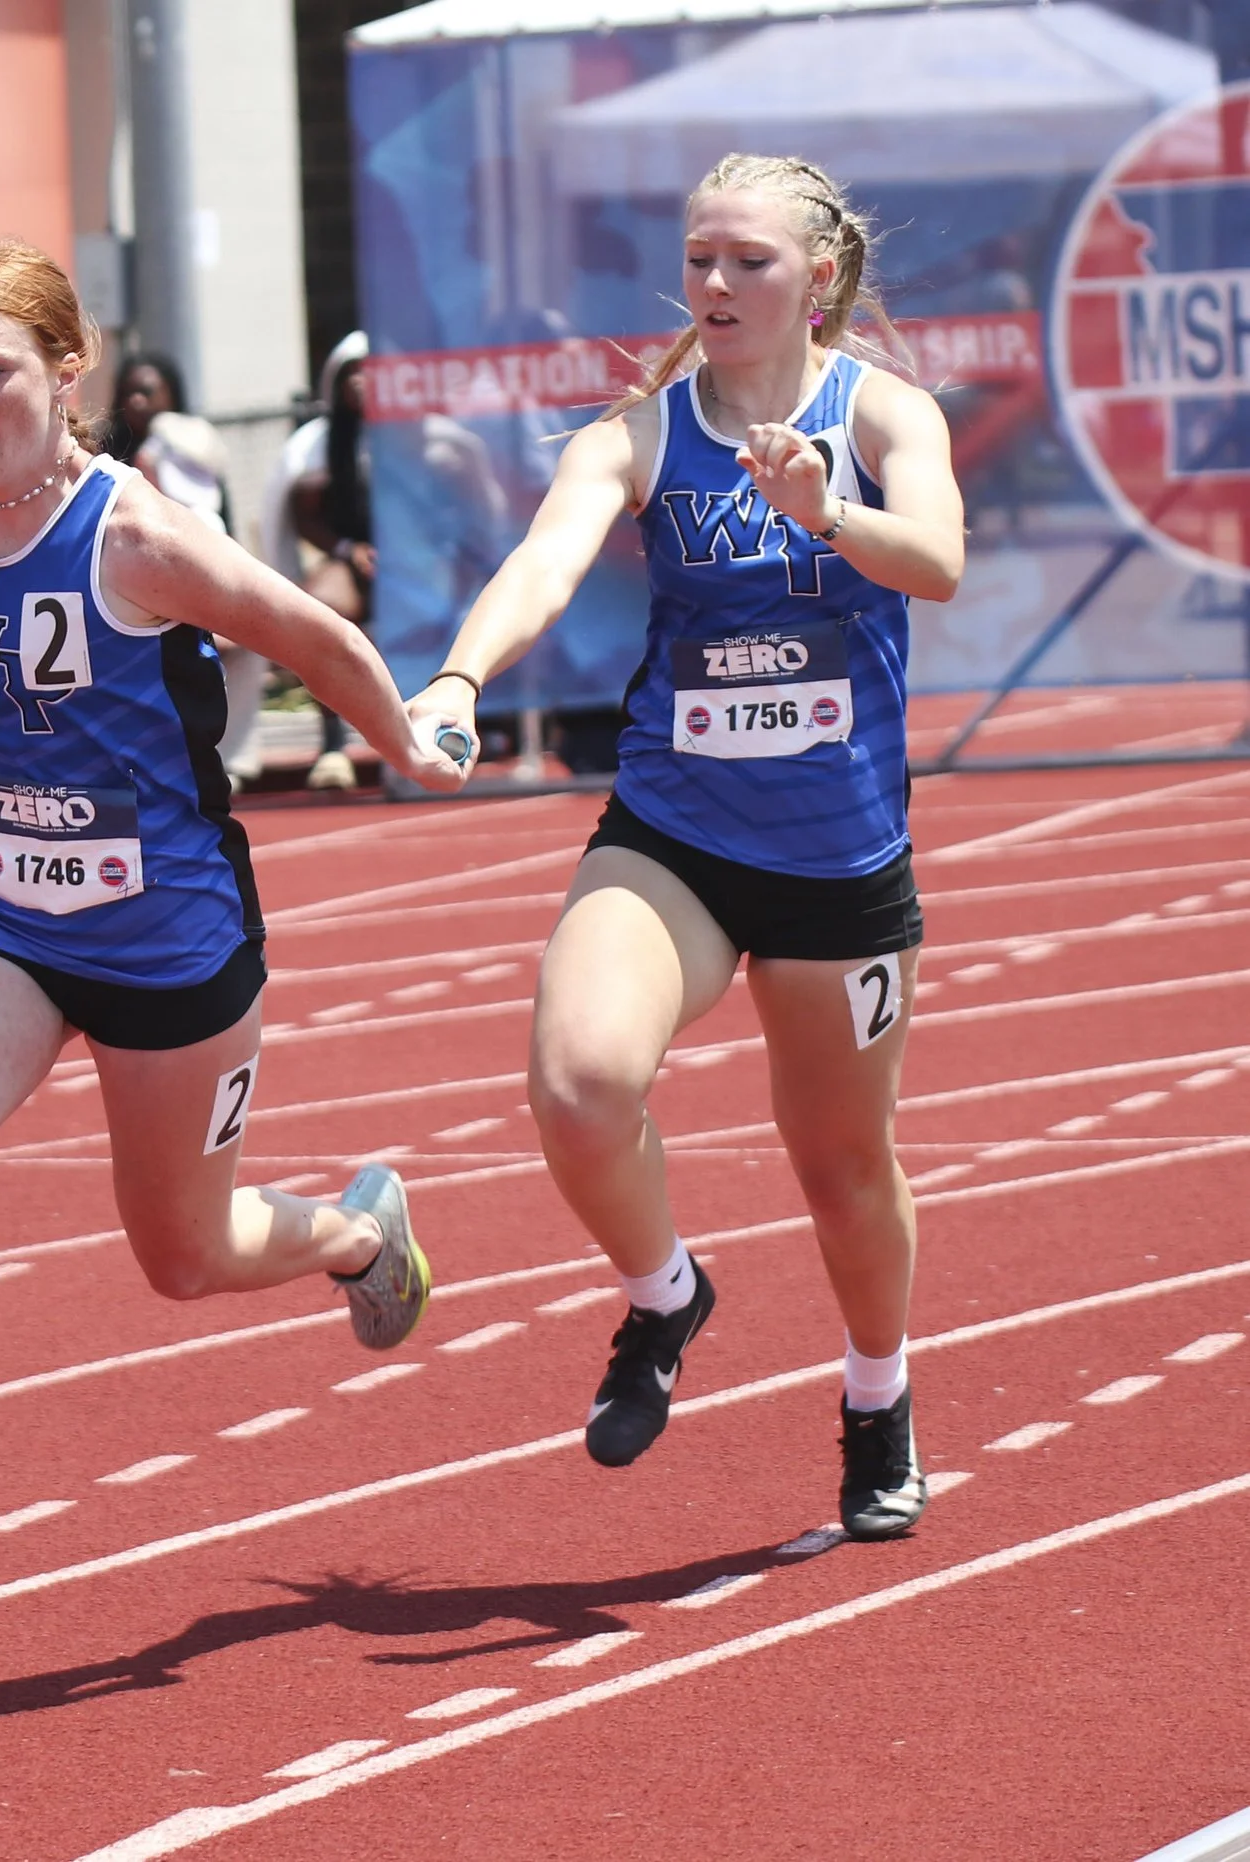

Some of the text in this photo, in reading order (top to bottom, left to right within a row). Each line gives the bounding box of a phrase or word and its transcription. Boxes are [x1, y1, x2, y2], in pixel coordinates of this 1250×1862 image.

[35, 598, 76, 685] 2
[723, 633, 781, 648] SHOW-ME
[703, 640, 809, 676] ZERO
[725, 700, 799, 731] 1756
[13, 784, 68, 798] SHOW-ME
[15, 853, 86, 885] 1746
[859, 963, 894, 1041] 2
[215, 1067, 251, 1147] 2
